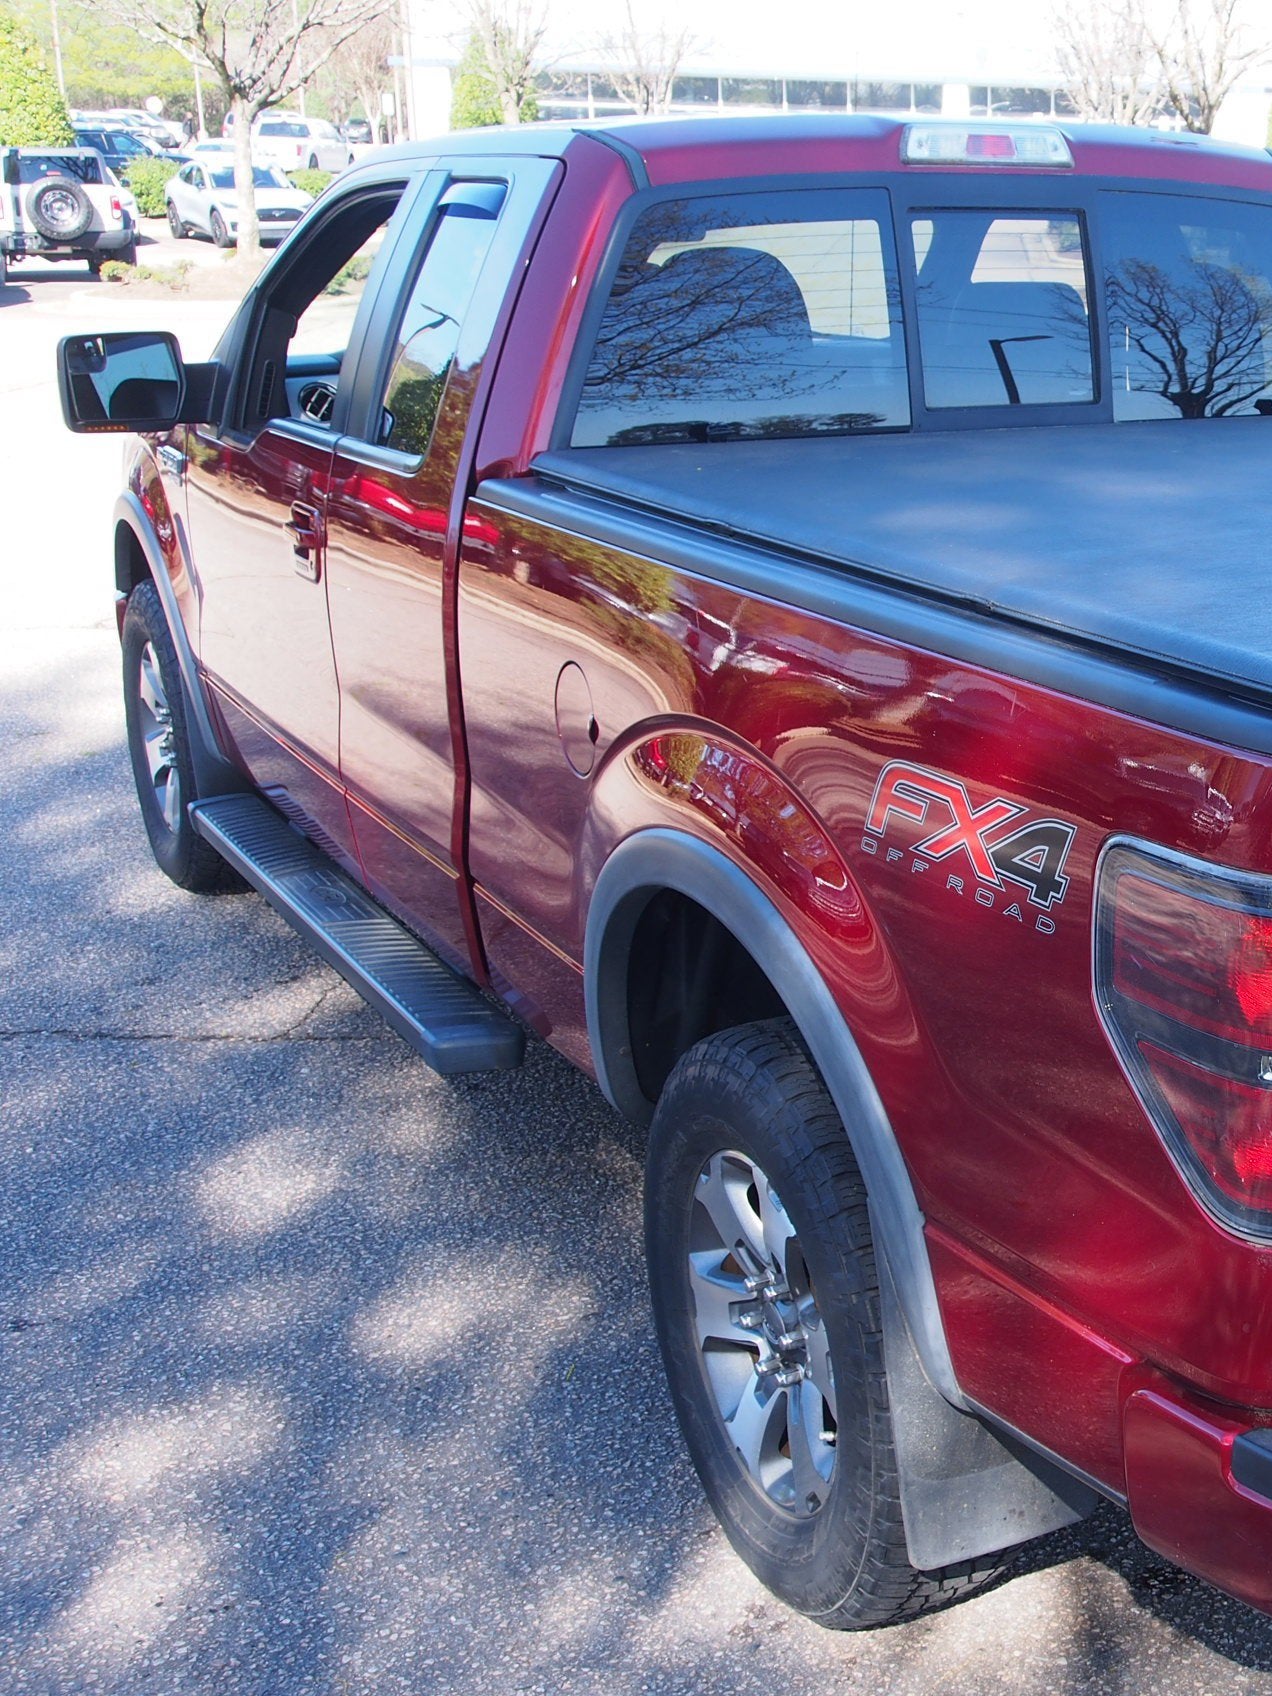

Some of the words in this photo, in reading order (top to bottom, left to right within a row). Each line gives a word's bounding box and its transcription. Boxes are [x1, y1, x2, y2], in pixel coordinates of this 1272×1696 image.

[860, 836, 929, 873] OFF
[946, 874, 1056, 934] ROAD
[864, 759, 1078, 911] FX4
